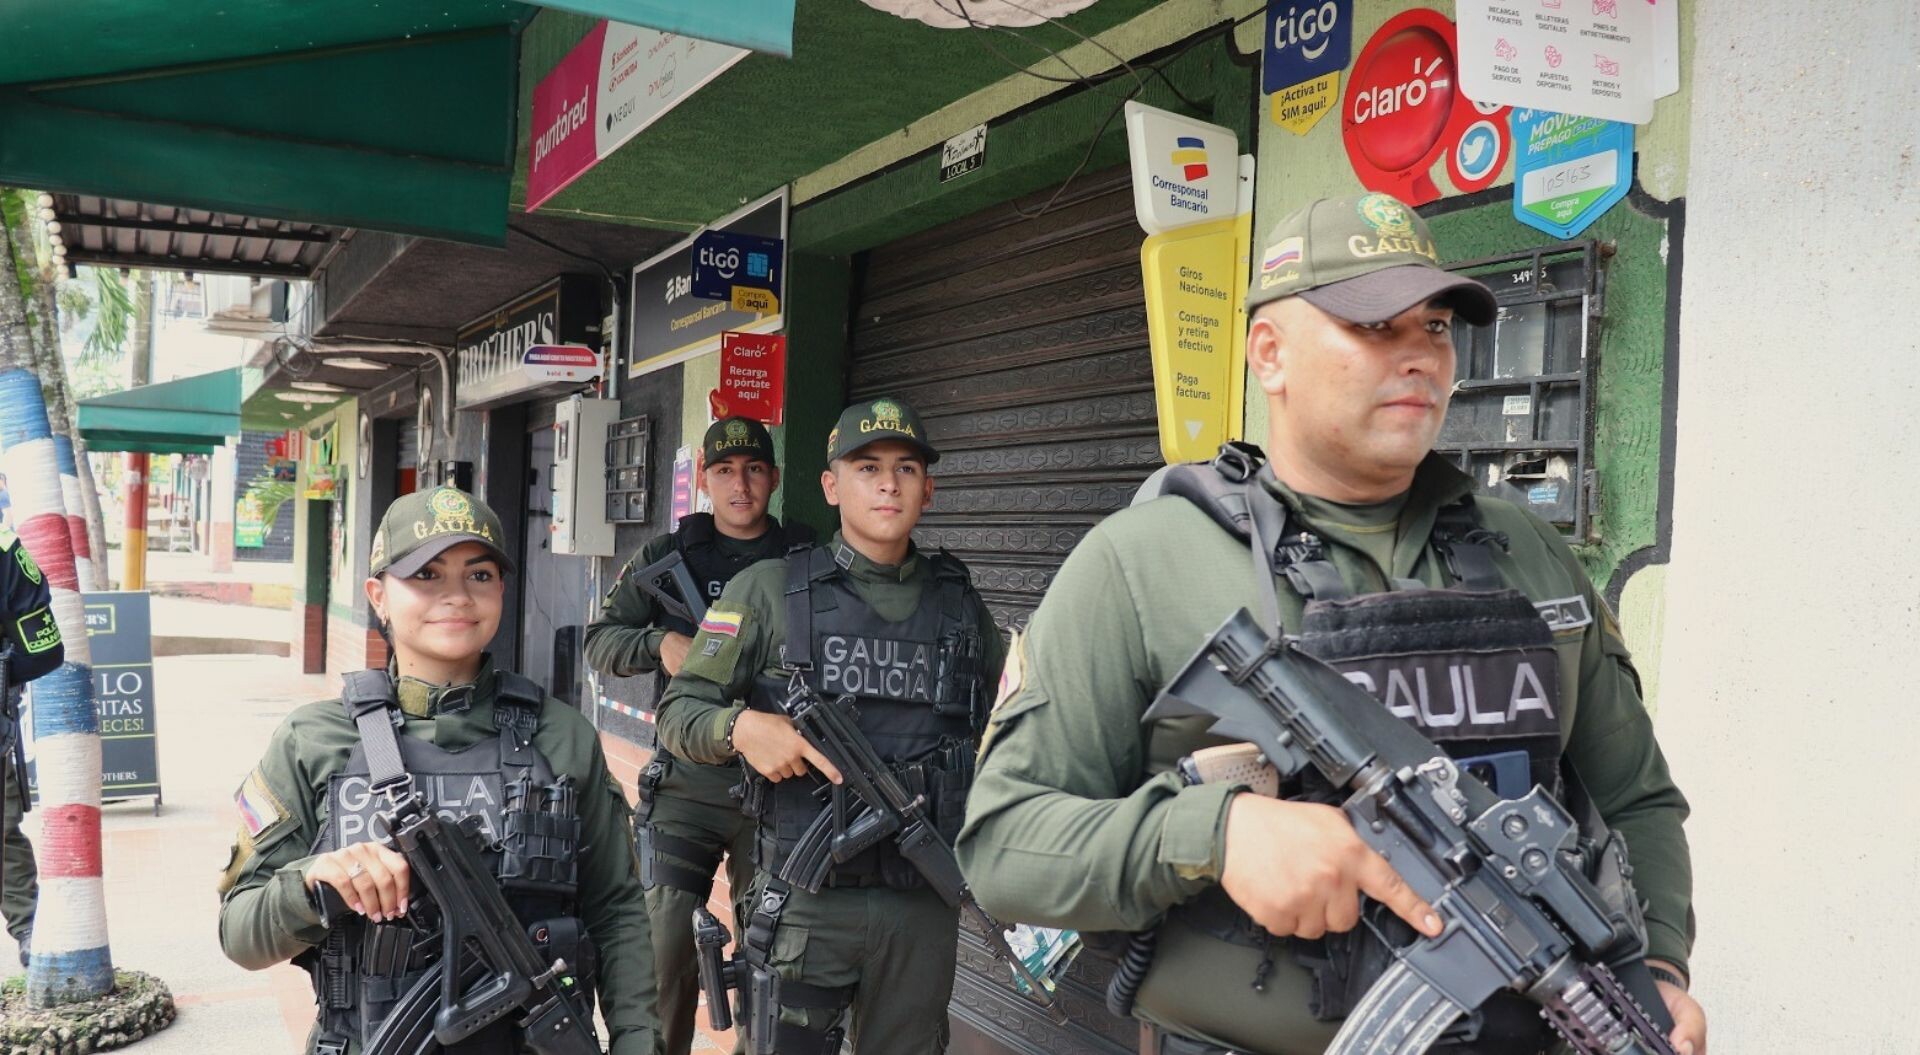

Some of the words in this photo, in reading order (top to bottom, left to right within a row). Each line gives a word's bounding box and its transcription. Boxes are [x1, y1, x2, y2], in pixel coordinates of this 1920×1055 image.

[1488, 6, 1520, 17] RECARGAS
[1492, 16, 1522, 26] PAQUETES
[1538, 23, 1567, 33] DIGITALES
[1275, 1, 1337, 59] tigo
[1494, 64, 1509, 73] PAGO
[1491, 73, 1521, 84] SERVICIOS
[1540, 72, 1569, 82] APUESTAS
[1592, 80, 1615, 89] RETIROS
[1317, 81, 1328, 92] tu
[1537, 80, 1572, 91] DEPORTIVAS
[1354, 79, 1427, 124] Claro
[1281, 106, 1300, 121] SIM
[1152, 175, 1208, 200] Corresponsal
[1170, 194, 1208, 213] Bancario
[700, 247, 740, 279] tigo
[1179, 265, 1203, 281] Giros
[1179, 281, 1227, 300] Nacionales
[1178, 310, 1219, 328] Consigna
[1178, 326, 1184, 336] y
[1186, 326, 1209, 339] retira
[734, 346, 762, 358] Claro
[1178, 338, 1213, 353] efectivo
[730, 365, 767, 379] Recarga
[1177, 372, 1198, 386] Paga
[1176, 385, 1211, 400] facturas
[860, 418, 916, 438] GAULA
[715, 438, 761, 452] GAULA
[413, 520, 493, 542] GAULA
[823, 635, 929, 671] GAULA
[102, 671, 142, 696] LO
[822, 664, 930, 700] POLICIA
[99, 718, 145, 733] ECES!
